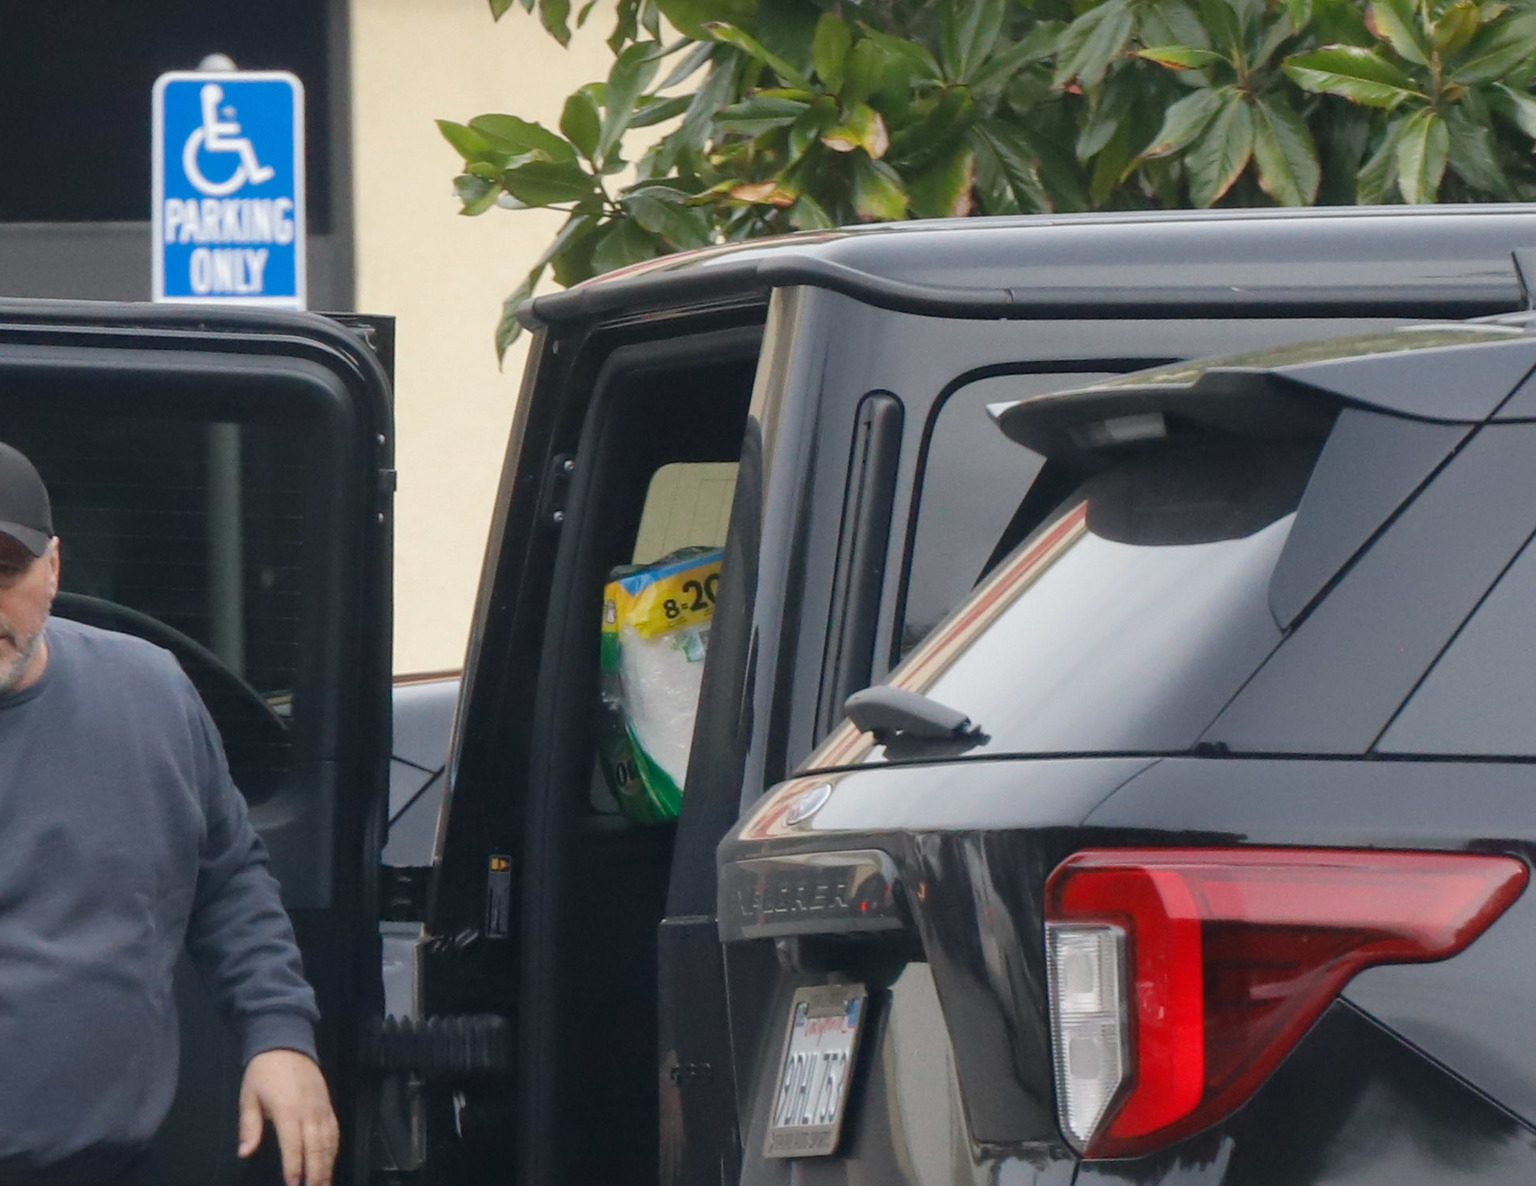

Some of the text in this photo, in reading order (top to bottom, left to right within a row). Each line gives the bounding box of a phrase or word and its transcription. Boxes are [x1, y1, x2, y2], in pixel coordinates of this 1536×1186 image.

[165, 198, 293, 244] PARKING
[190, 247, 269, 293] ONLY
[775, 1053, 848, 1126] 9DHL753
